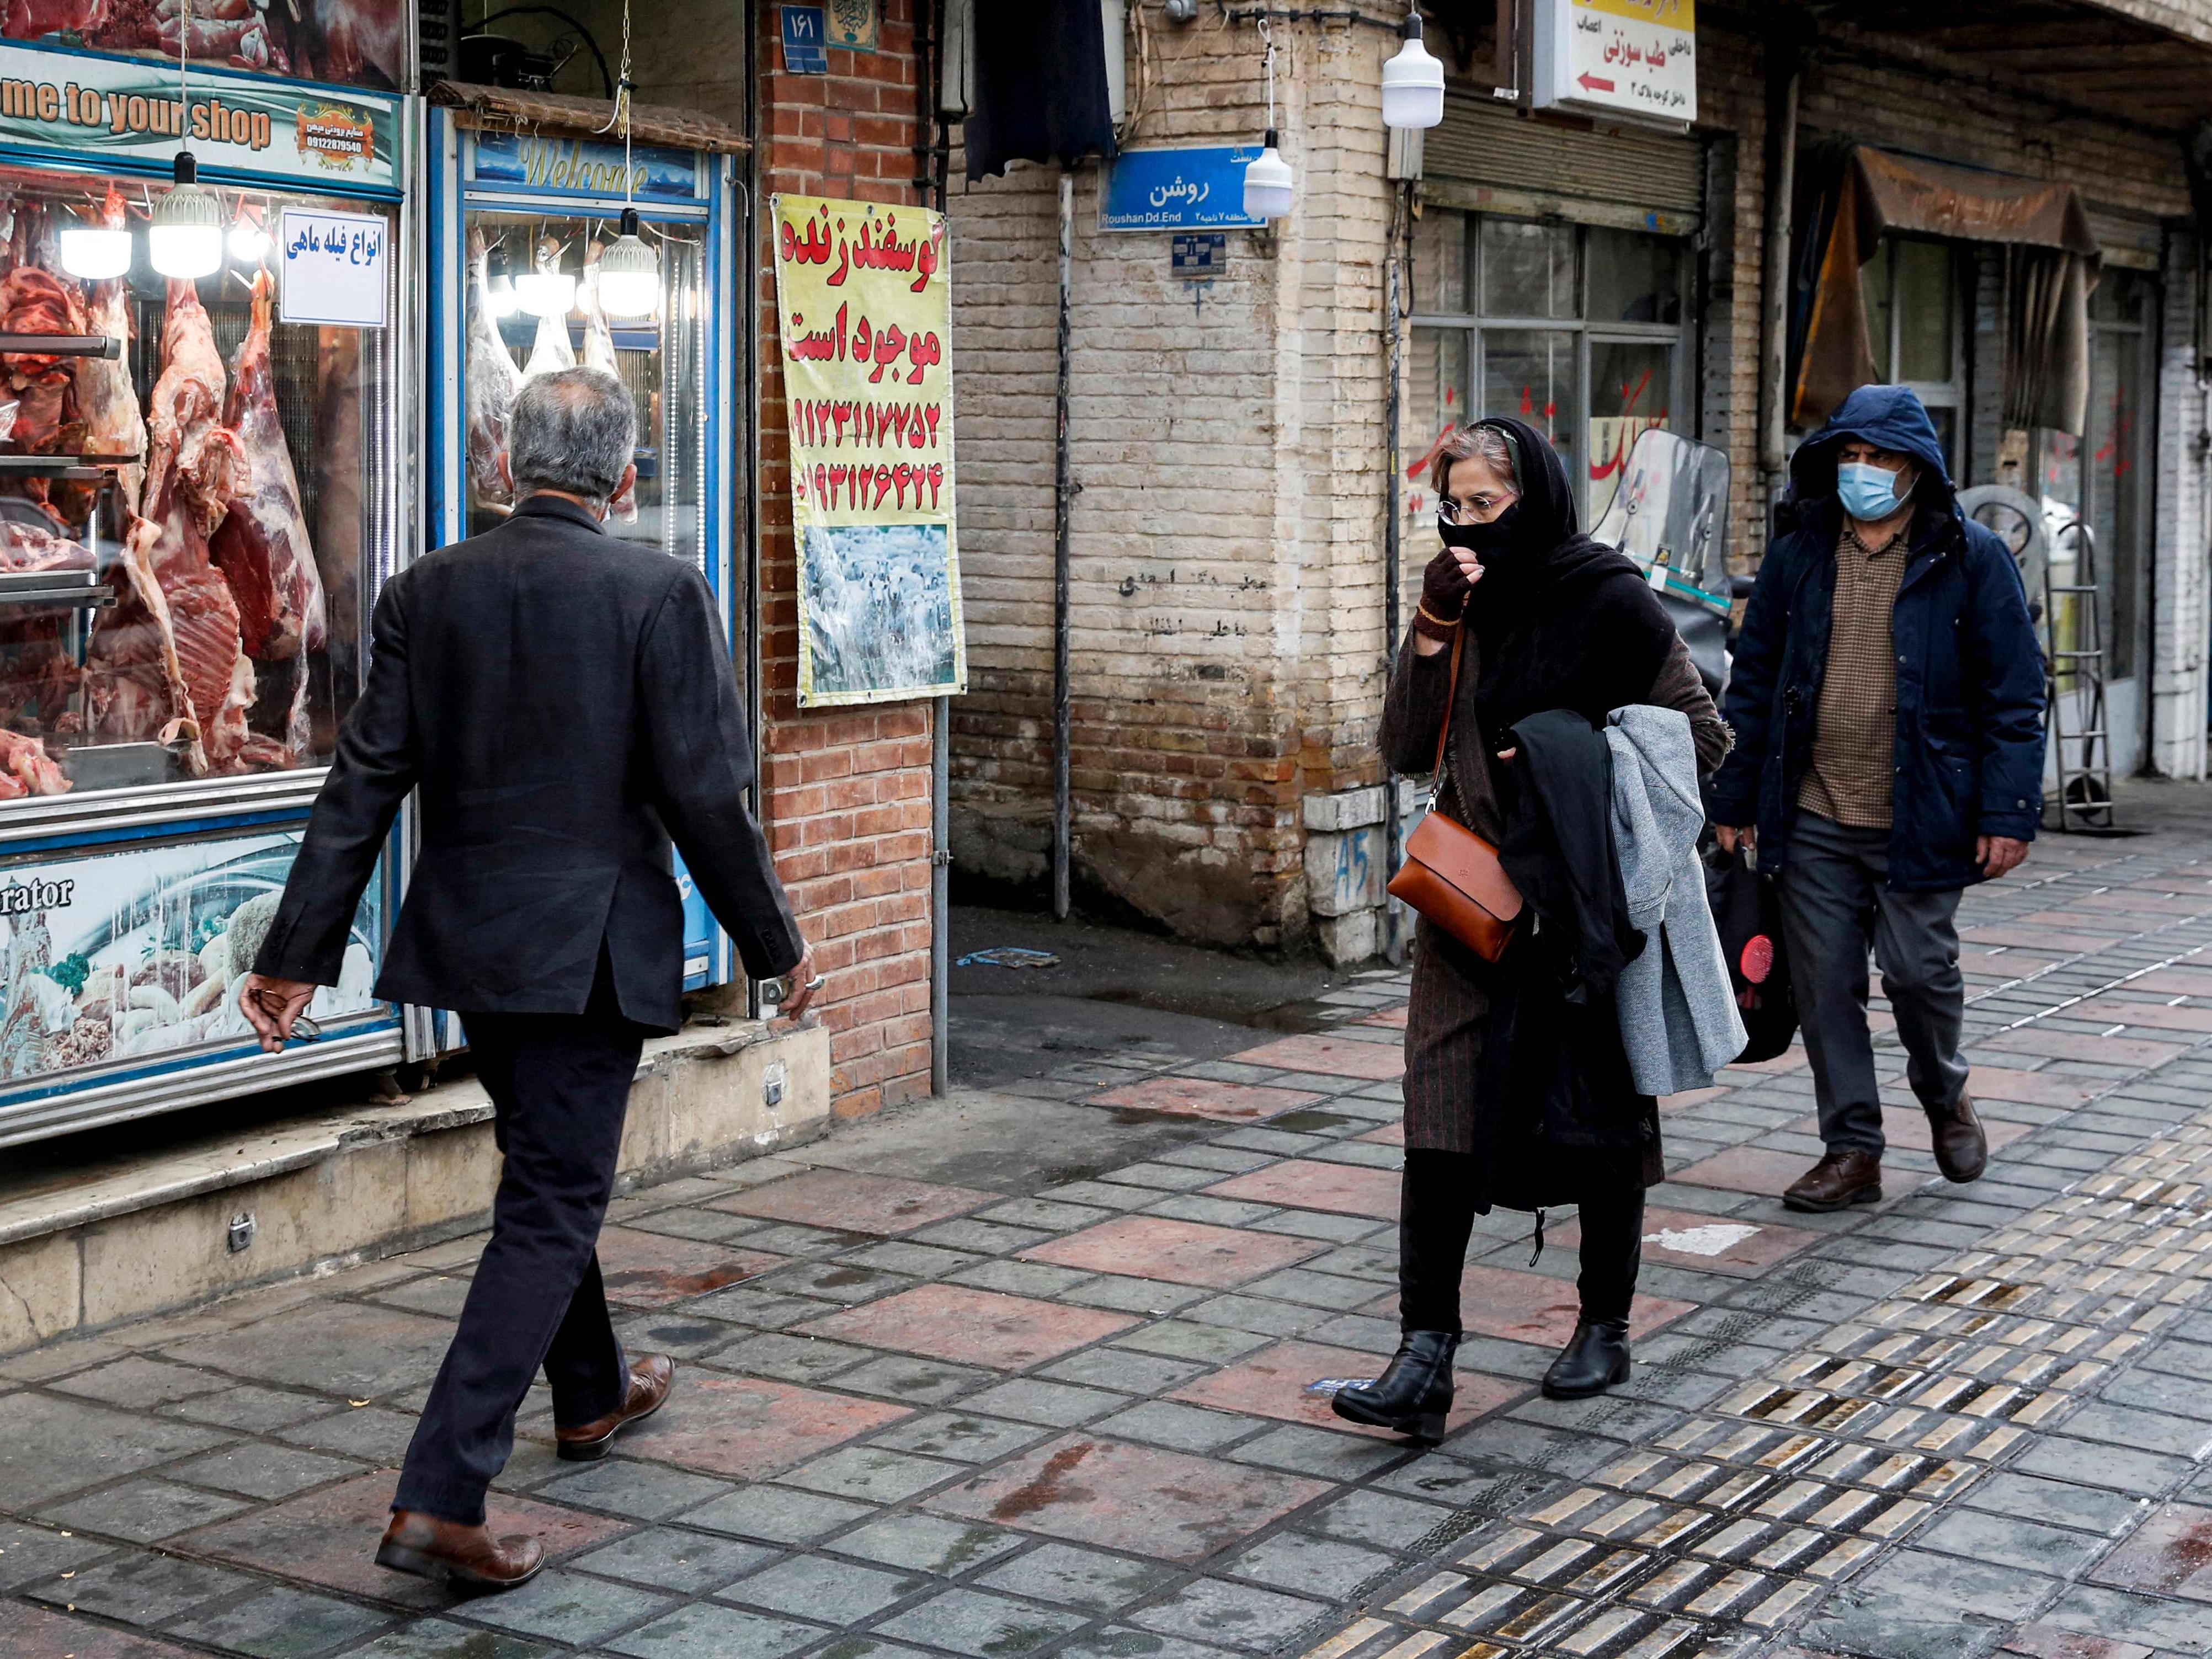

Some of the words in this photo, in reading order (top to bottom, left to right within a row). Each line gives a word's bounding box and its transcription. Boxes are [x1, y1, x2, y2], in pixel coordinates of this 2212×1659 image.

[791, 14, 814, 38] ۱۶۱
[1604, 29, 1641, 67] سوزنی
[1645, 40, 1666, 73] طب
[0, 78, 58, 122] me
[65, 82, 102, 127] to
[107, 91, 184, 136] your
[191, 98, 271, 152] shop
[306, 136, 362, 153] 09122879540
[519, 138, 649, 194] Welcome
[1149, 175, 1210, 207] روشن
[1101, 212, 1144, 225] Roushan
[286, 223, 320, 259] ماهی
[324, 225, 347, 262] فیله
[350, 229, 381, 266] انواع
[781, 204, 849, 286] زنده
[787, 300, 847, 362] است
[852, 315, 941, 385] موجود
[0, 877, 74, 916] rator
